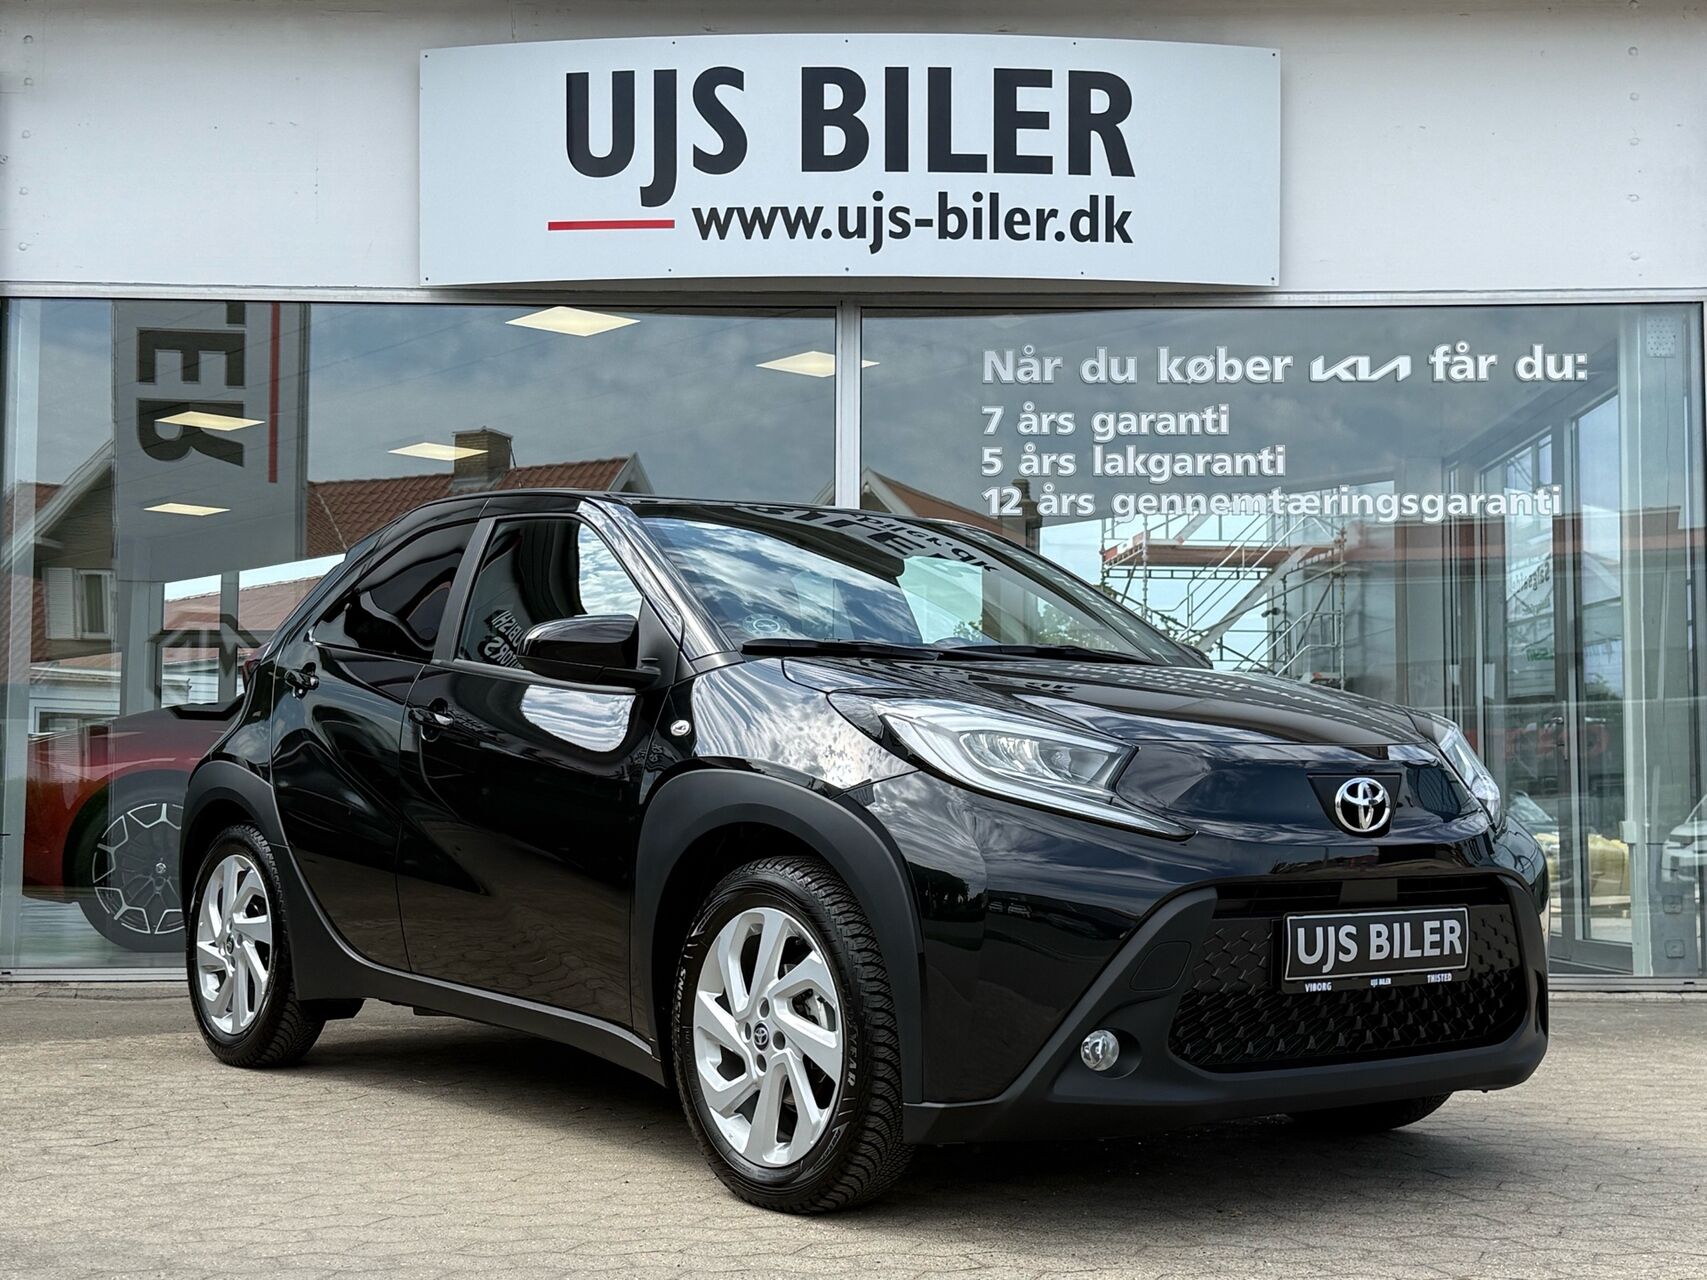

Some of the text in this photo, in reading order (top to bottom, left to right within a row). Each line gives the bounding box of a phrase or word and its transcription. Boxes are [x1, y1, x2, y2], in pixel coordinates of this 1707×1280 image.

[565, 66, 1136, 208] UJS BILER
[691, 189, 1134, 255] www.ujs-biler.dk
[981, 340, 1590, 385] Når du køber KIA får du:
[981, 401, 1230, 445] 7 års garanti
[981, 443, 1286, 485] 5 års lakgaranti
[981, 484, 1562, 526] 12 års gennemtæringsgaranti
[1296, 919, 1463, 974] UJS BILER
[1304, 982, 1333, 993] VIBORG
[1427, 972, 1453, 984] THISTED
